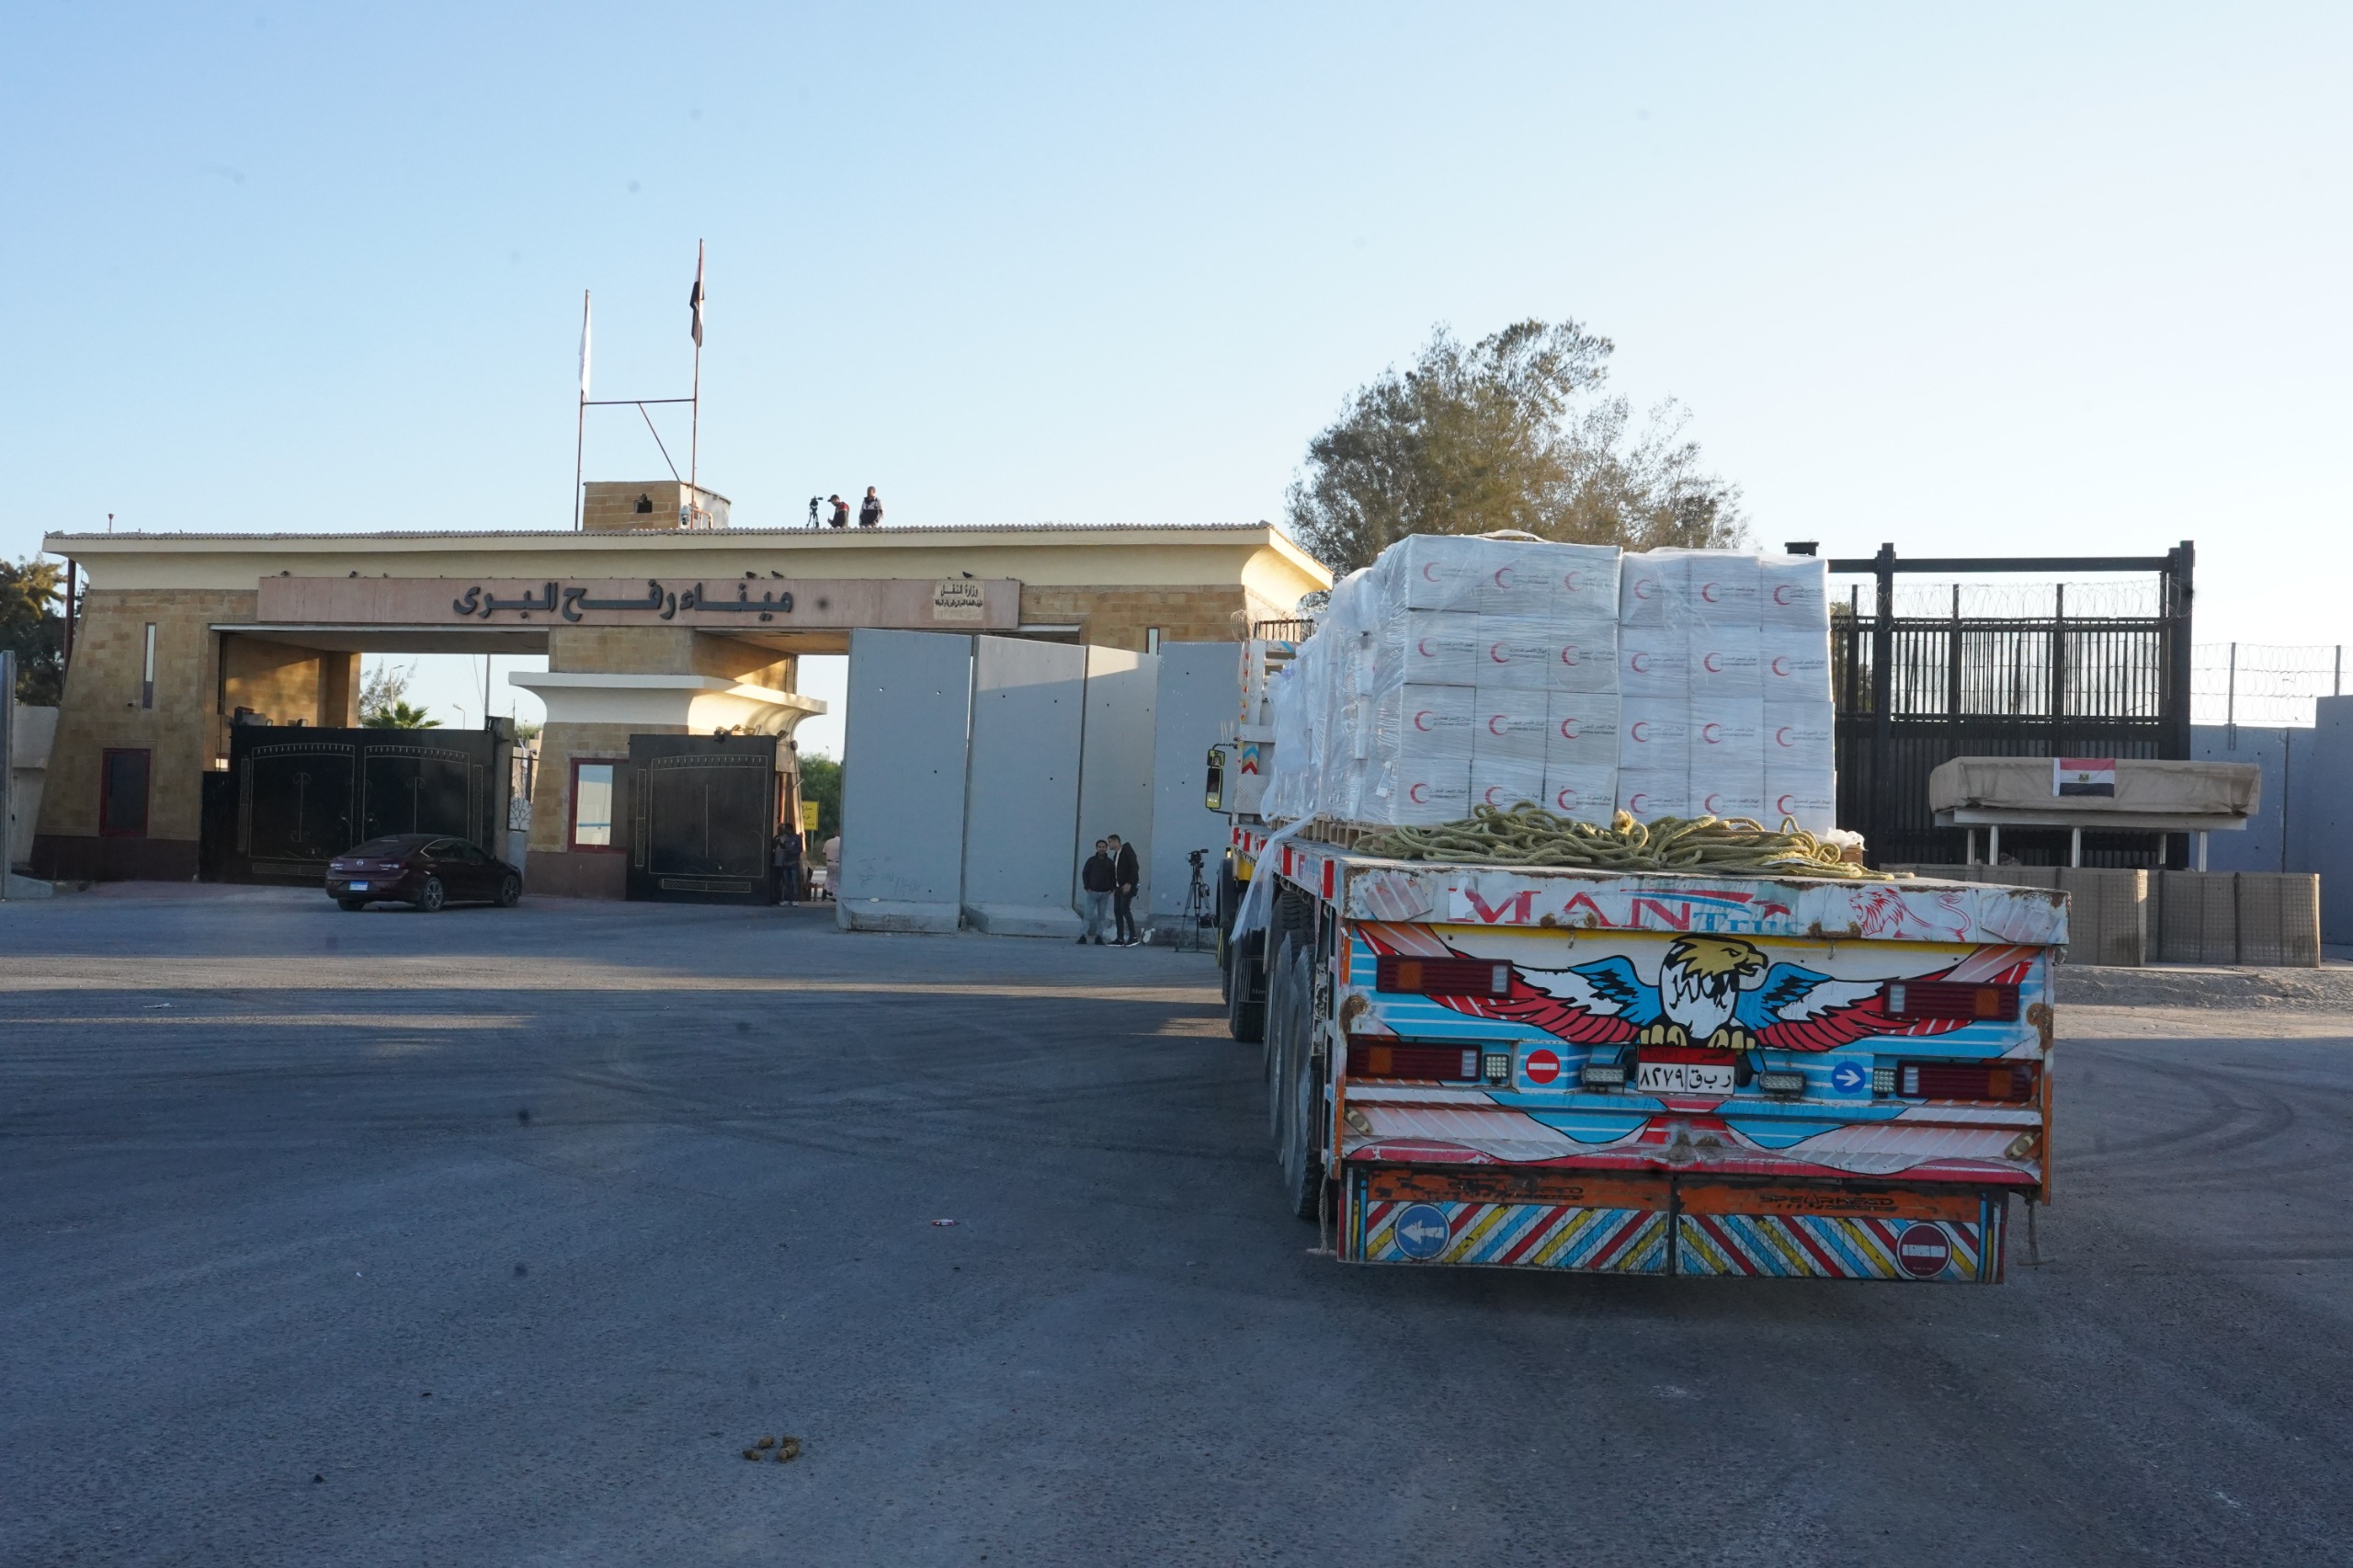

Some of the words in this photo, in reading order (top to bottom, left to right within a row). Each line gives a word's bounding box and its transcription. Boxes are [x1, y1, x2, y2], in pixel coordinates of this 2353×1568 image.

[562, 579, 676, 622] رفح
[679, 581, 793, 621] ميناء
[1447, 888, 1690, 930] MAN
[1640, 1067, 1684, 1087] ٨٢٧٩
